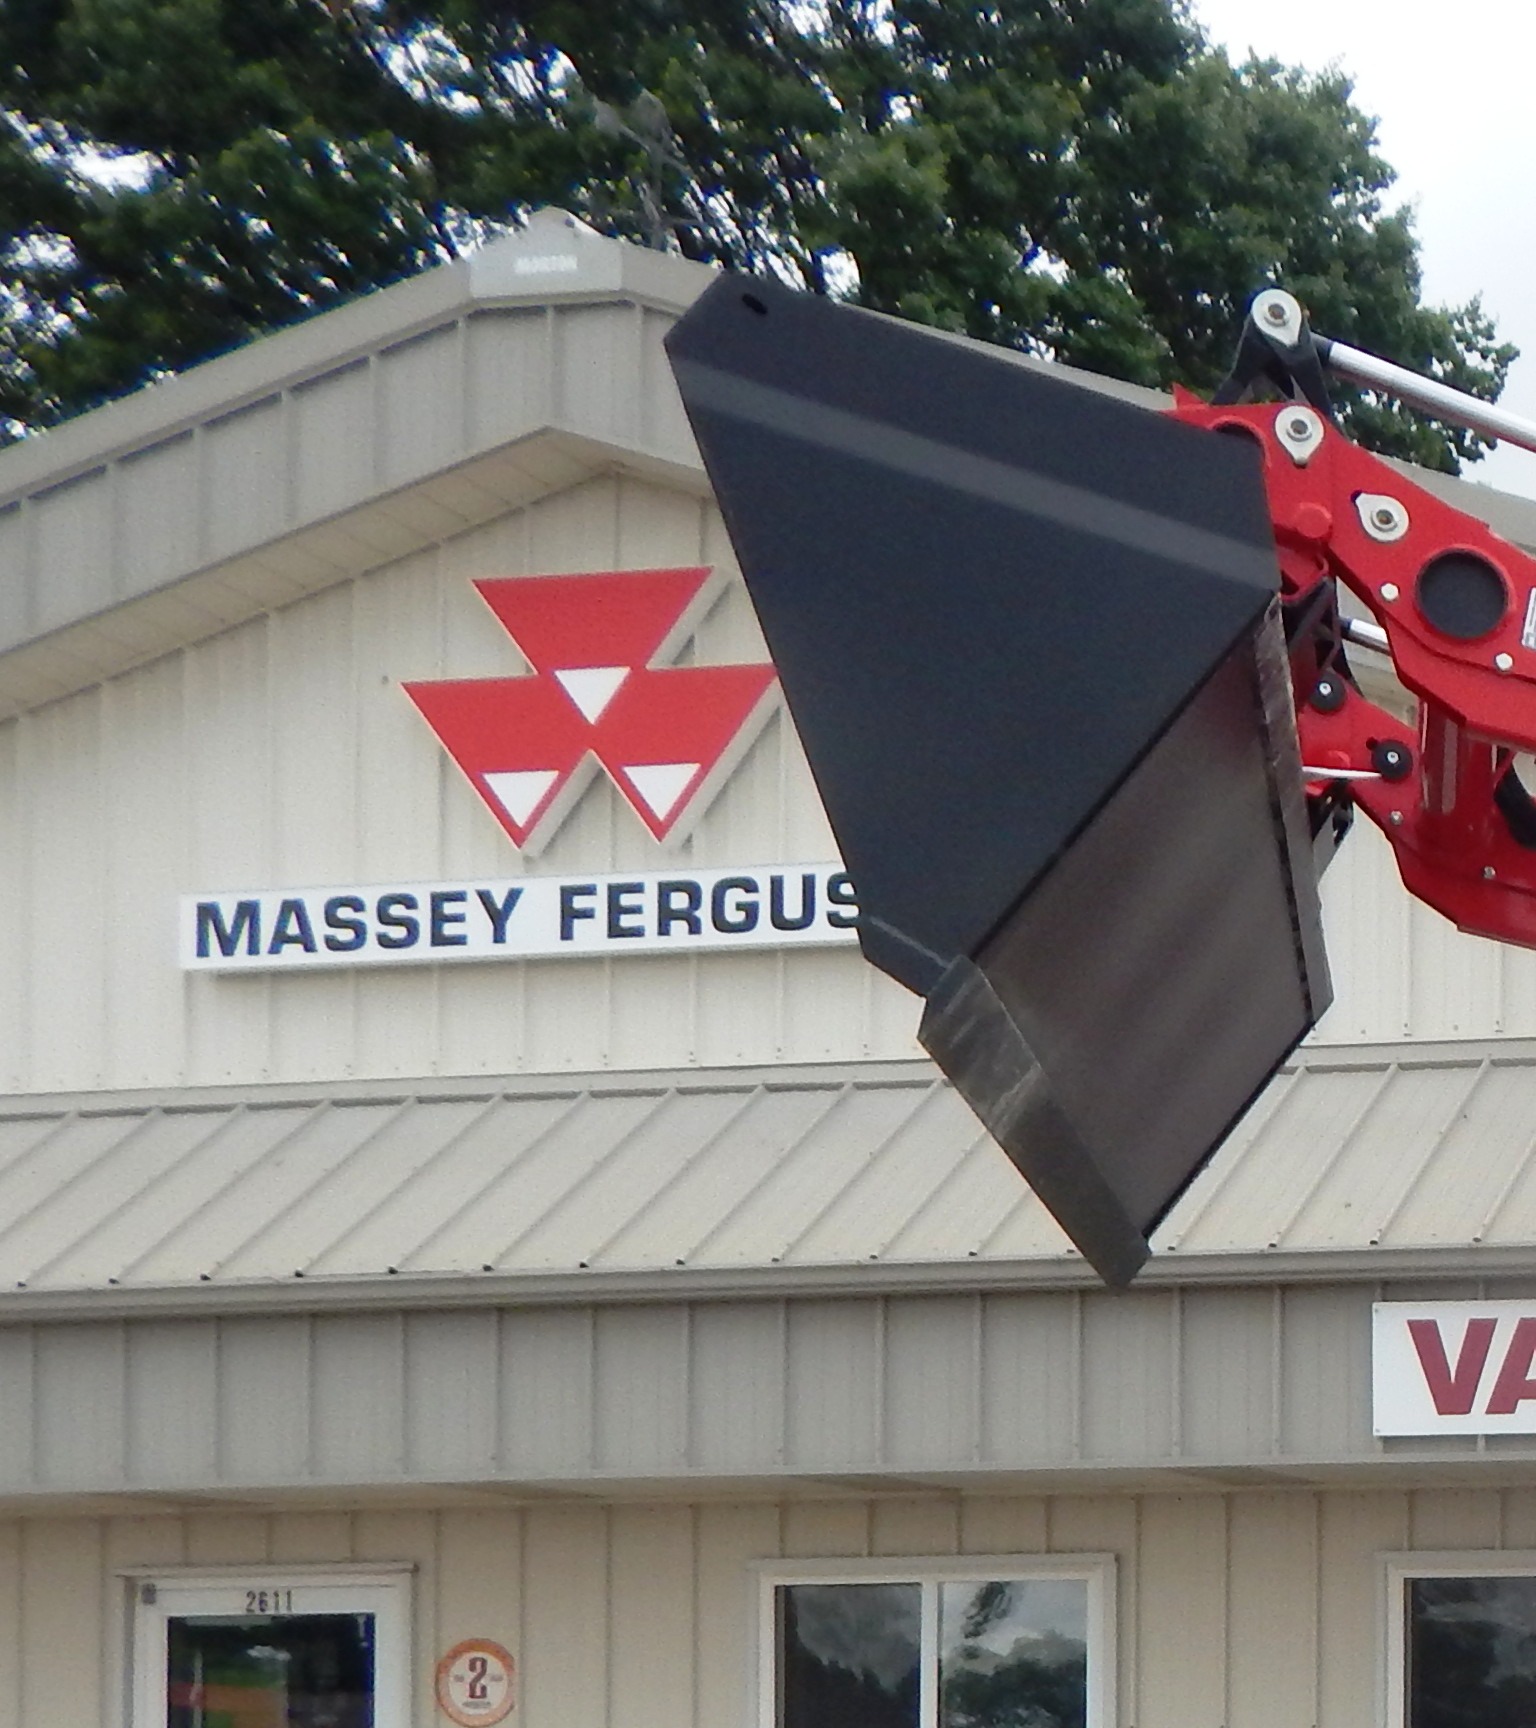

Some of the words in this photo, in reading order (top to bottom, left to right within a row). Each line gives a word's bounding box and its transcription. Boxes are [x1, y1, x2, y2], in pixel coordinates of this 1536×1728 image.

[195, 886, 525, 958] MASSEY
[245, 1590, 293, 1613] 2611
[468, 1656, 488, 1699] 2
